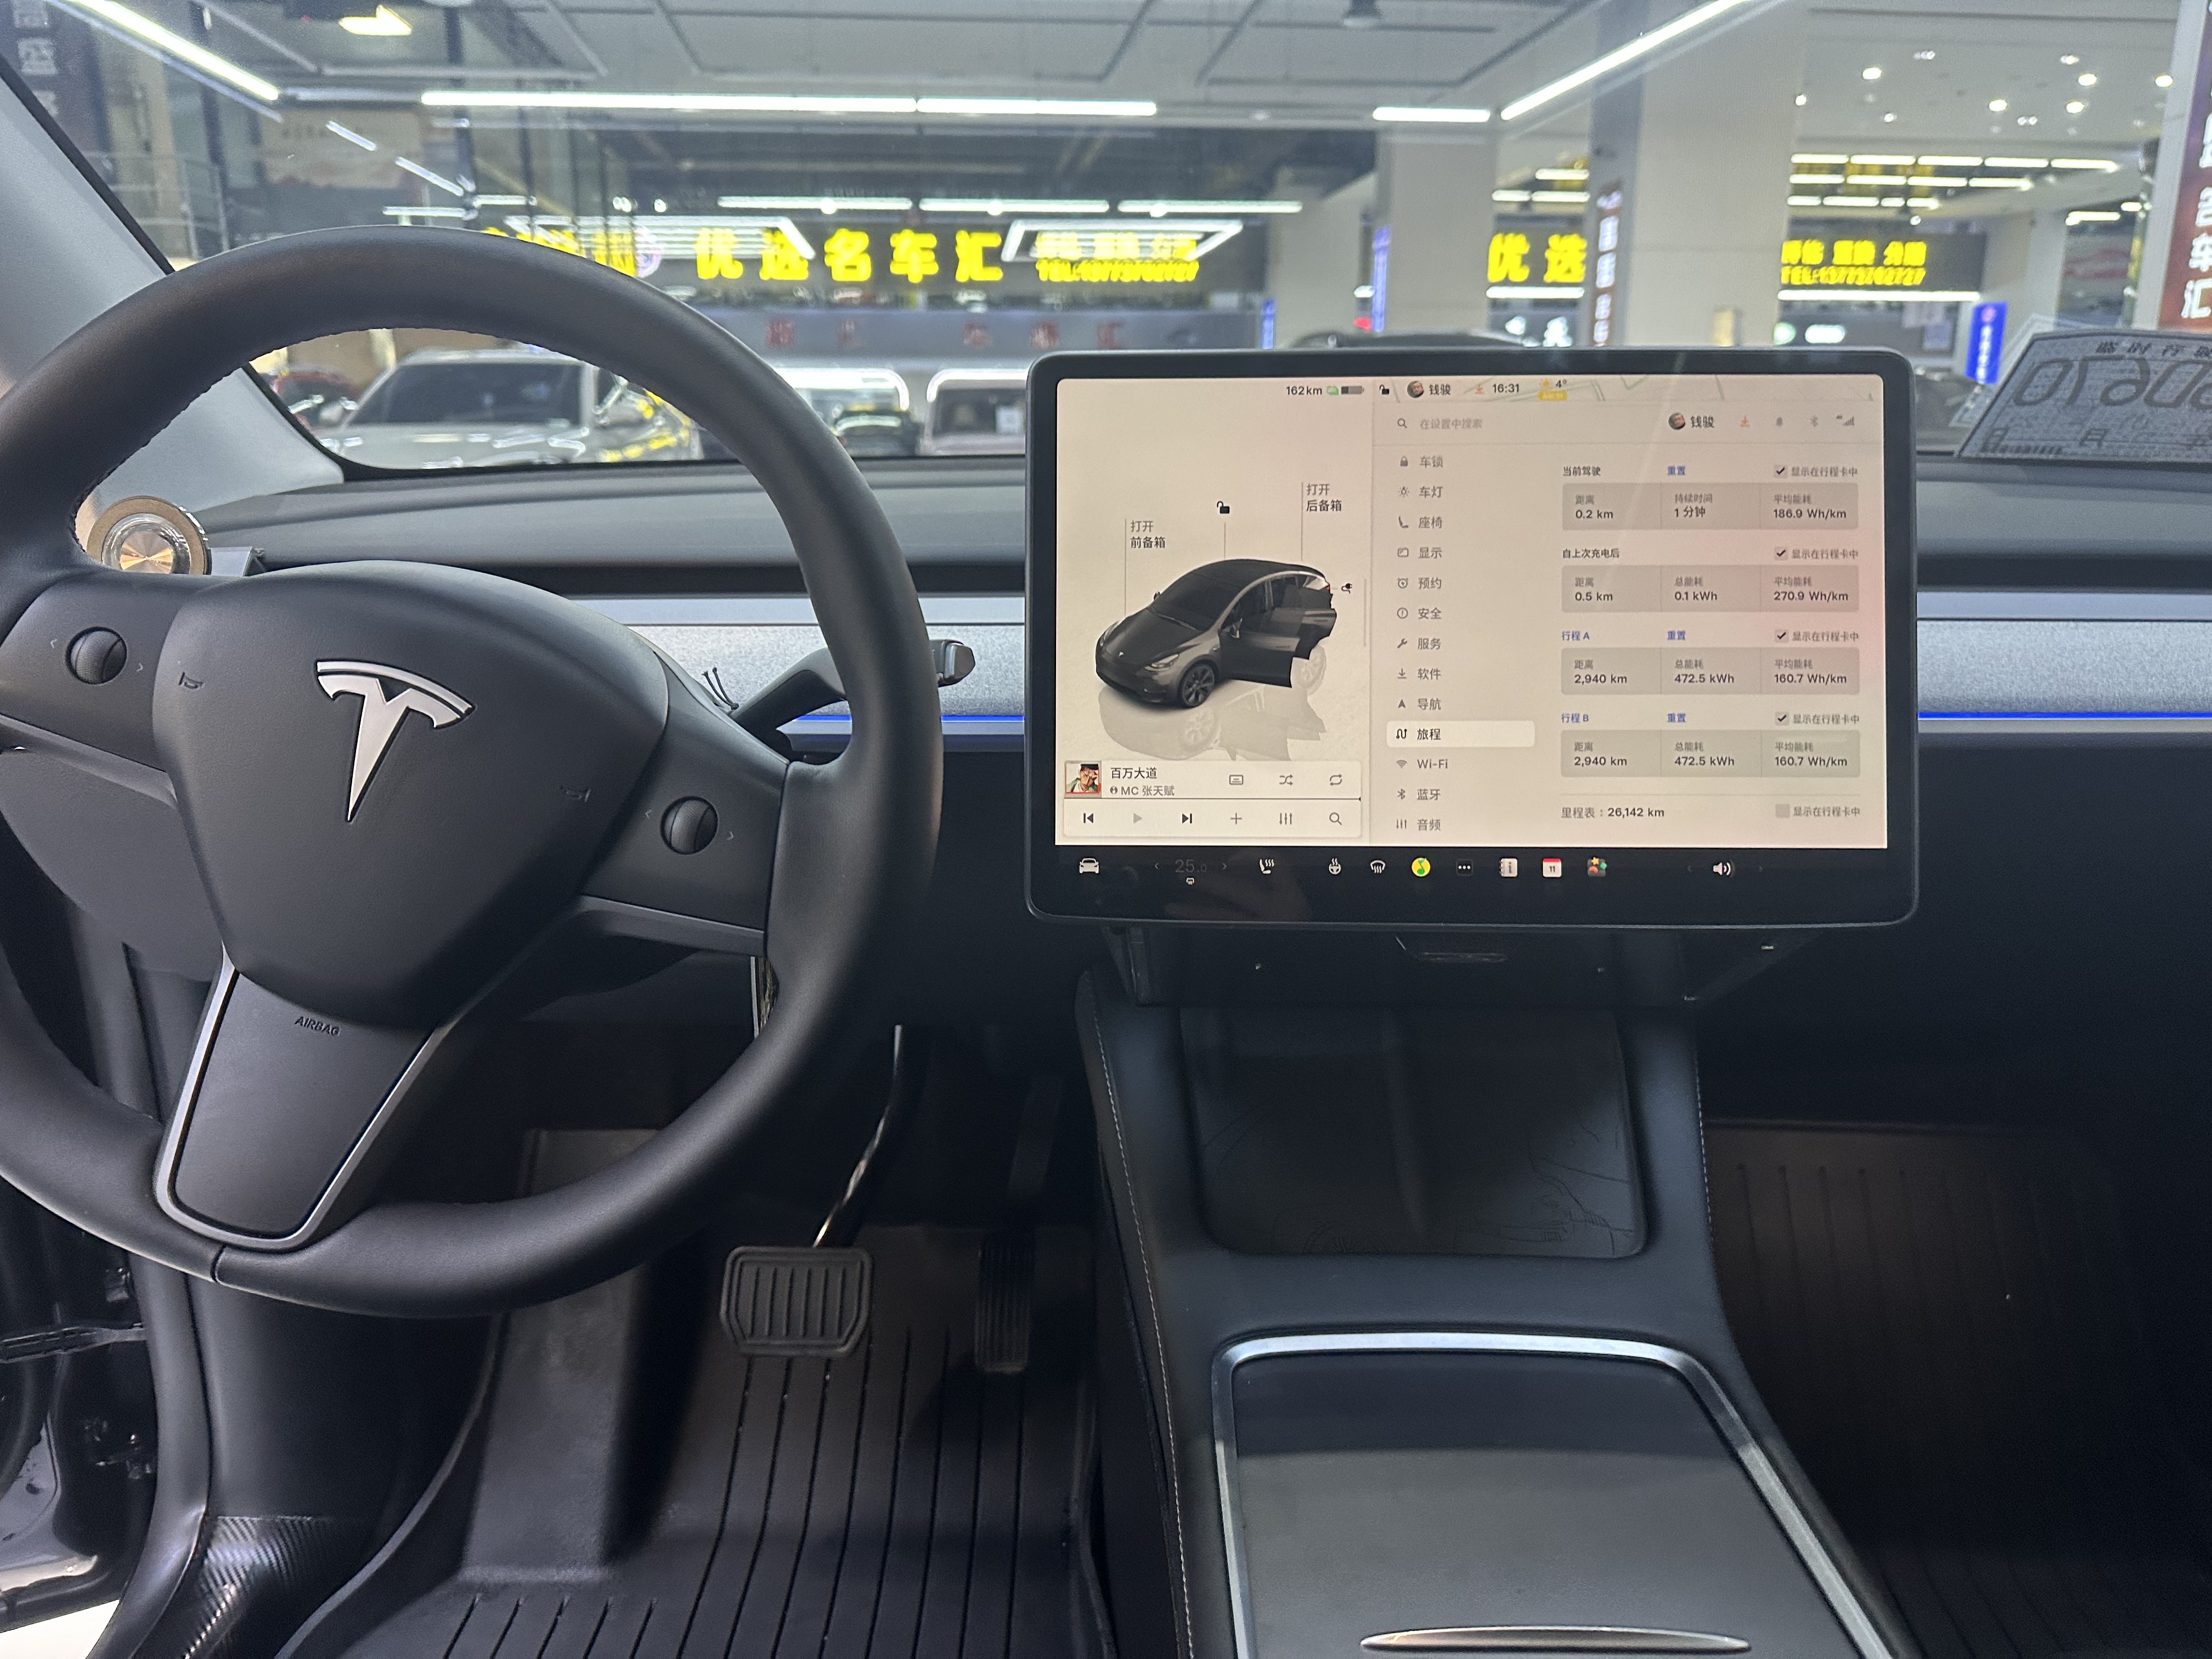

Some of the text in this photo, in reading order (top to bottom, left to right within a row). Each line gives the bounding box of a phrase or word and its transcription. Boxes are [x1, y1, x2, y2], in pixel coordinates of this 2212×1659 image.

[1286, 386, 1322, 395] 162 km
[1492, 383, 1519, 393] 16:31
[1419, 456, 1443, 468] 车锁
[1563, 466, 1601, 476] 当前驾驶
[1306, 483, 1330, 495] 打开
[1419, 486, 1443, 498] 车灯
[1575, 494, 1594, 505] 距离
[1306, 499, 1342, 512] 后备箱
[1575, 510, 1613, 519] 0.2 km
[1674, 506, 1706, 517] 1 分钟
[1807, 508, 1847, 520] Wh/km
[1130, 521, 1154, 533] 打开
[1419, 516, 1443, 529] 座椅
[1130, 536, 1166, 549] 前备箱
[1418, 547, 1442, 559] 显示
[1562, 548, 1620, 558] 自上次充电后
[1418, 577, 1442, 589] 预约
[1575, 577, 1594, 588] 距离
[1674, 577, 1703, 587] 总能耗
[1575, 591, 1613, 601] 0.5 km
[1674, 591, 1717, 601] 0.1 kWh
[1774, 590, 1849, 602] 270.9 Wh/km
[1418, 607, 1442, 620] 安全
[1561, 630, 1581, 641] 行程
[1417, 637, 1441, 650] 服务
[1574, 659, 1594, 670] 距离
[1674, 659, 1704, 669] 总能耗
[1417, 668, 1442, 680] 软件
[1574, 674, 1627, 685] 2,940 km
[1674, 673, 1734, 683] 472.5 kWh
[1774, 674, 1847, 685] 160.7 Wh/km
[1417, 698, 1442, 710] 导航
[1561, 713, 1580, 723] 行程
[1417, 728, 1441, 741] 旅程
[1574, 741, 1593, 752] 距离
[1674, 741, 1704, 752] 总能耗
[1417, 758, 1448, 769] Wi-Fi
[1574, 757, 1627, 767] 2,940 km
[1674, 756, 1735, 766] 472.5 kWh
[1775, 756, 1848, 768] 160.7 Wh/km
[1110, 767, 1158, 779] 百万大道
[1121, 785, 1175, 797] MC 张天赋
[1417, 788, 1441, 801] 蓝牙
[1607, 807, 1644, 818] 26,142
[1647, 807, 1664, 817] km
[1417, 819, 1441, 831] 音频
[1175, 859, 1207, 873] 25.0
[295, 1016, 341, 1036] AIRBAG
